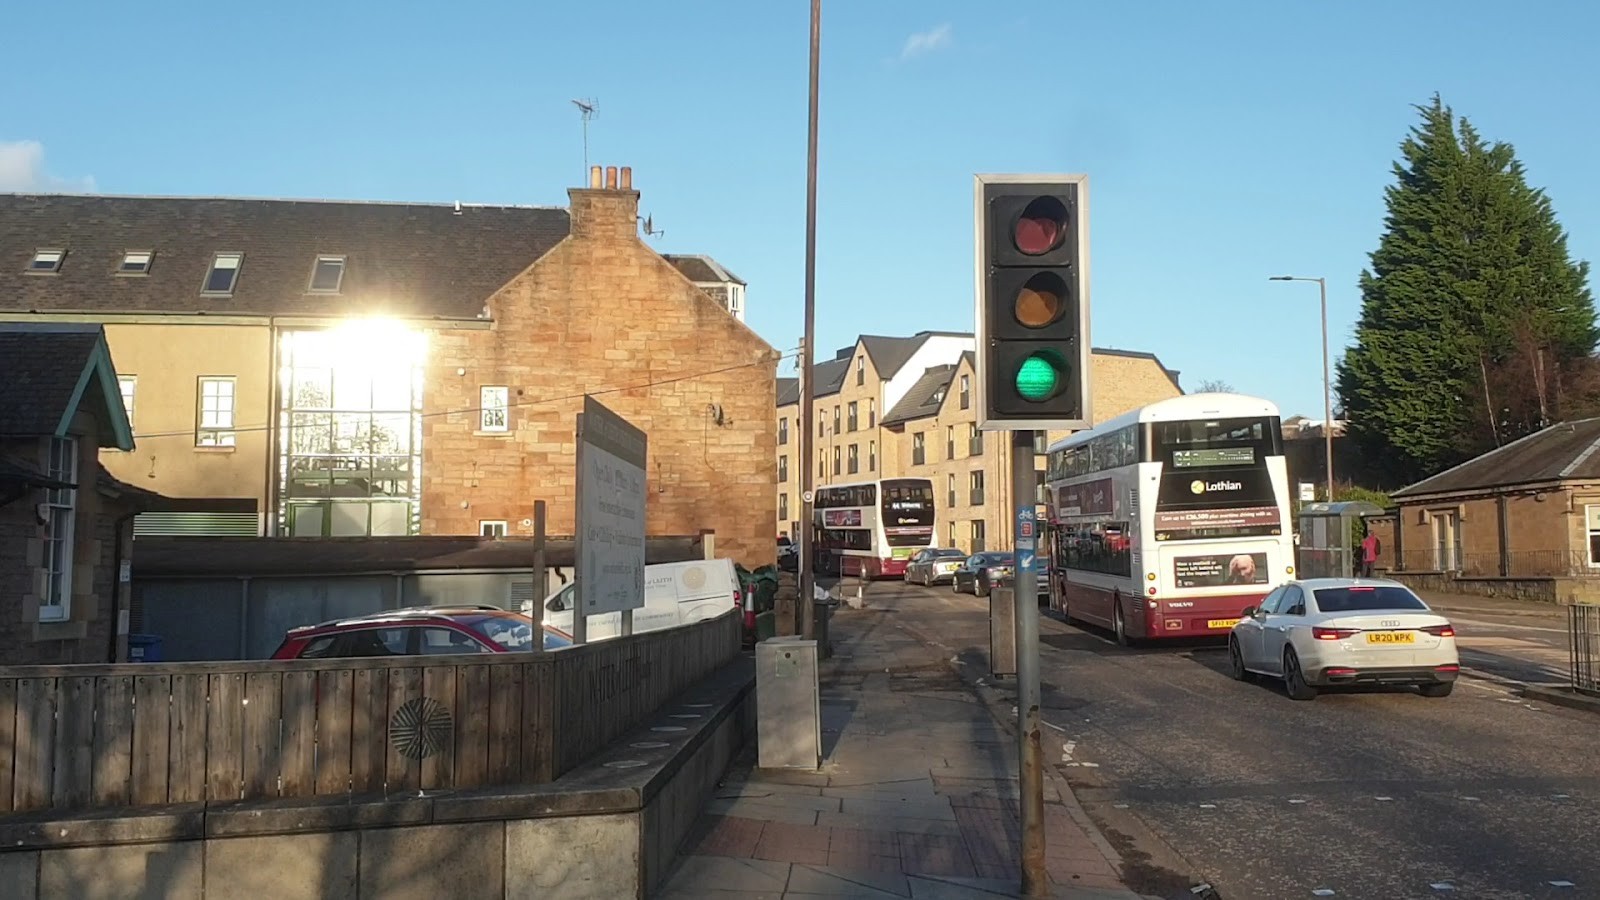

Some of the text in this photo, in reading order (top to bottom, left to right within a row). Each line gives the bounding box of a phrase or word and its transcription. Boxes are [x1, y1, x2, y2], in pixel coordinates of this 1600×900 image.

[1205, 481, 1242, 492] Lothian
[1369, 633, 1411, 643] LR20 WPK
